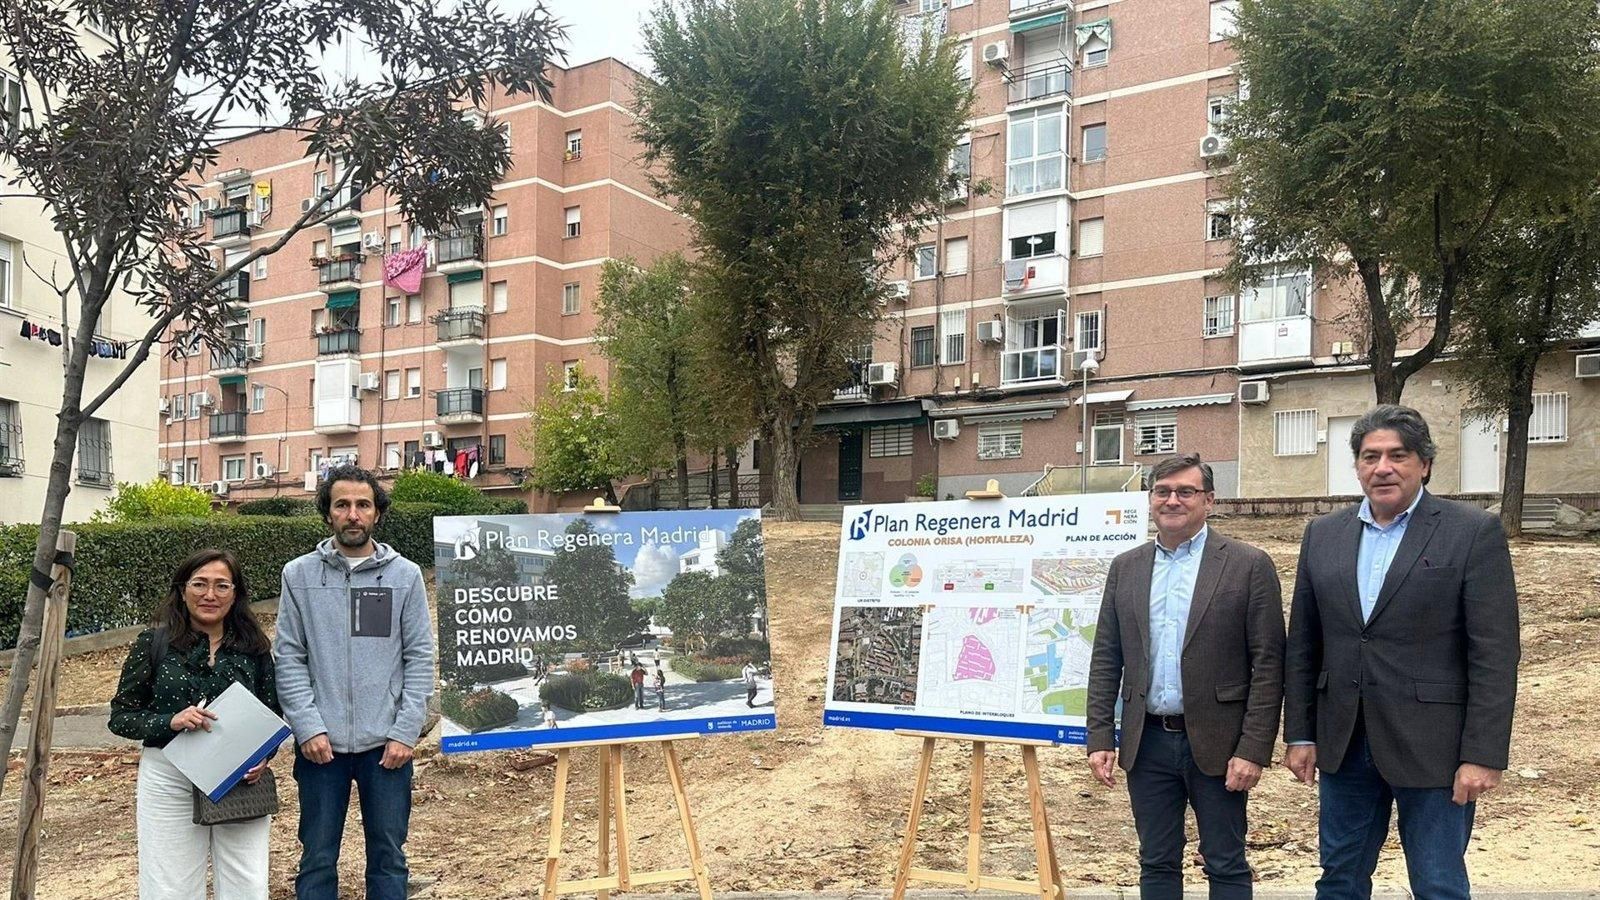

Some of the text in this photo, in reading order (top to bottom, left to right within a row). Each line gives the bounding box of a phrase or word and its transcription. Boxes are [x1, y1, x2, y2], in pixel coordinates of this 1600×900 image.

[874, 515, 909, 533] Plan
[915, 513, 1001, 536] Regenera
[1008, 507, 1079, 528] Madrid
[485, 530, 529, 550] Plan
[537, 529, 634, 552] Regenera
[641, 525, 709, 544] Madrid
[887, 534, 1035, 547] COLONIA ORISA (HORTALEZA)
[1089, 534, 1101, 542] DE
[1102, 532, 1137, 541] ACCIÓN
[454, 584, 559, 604] DESCUBRE
[455, 604, 513, 625] CÓMO
[456, 624, 578, 646] RENOVAMOS
[456, 647, 534, 667] MADRID
[741, 718, 771, 726] MADRID
